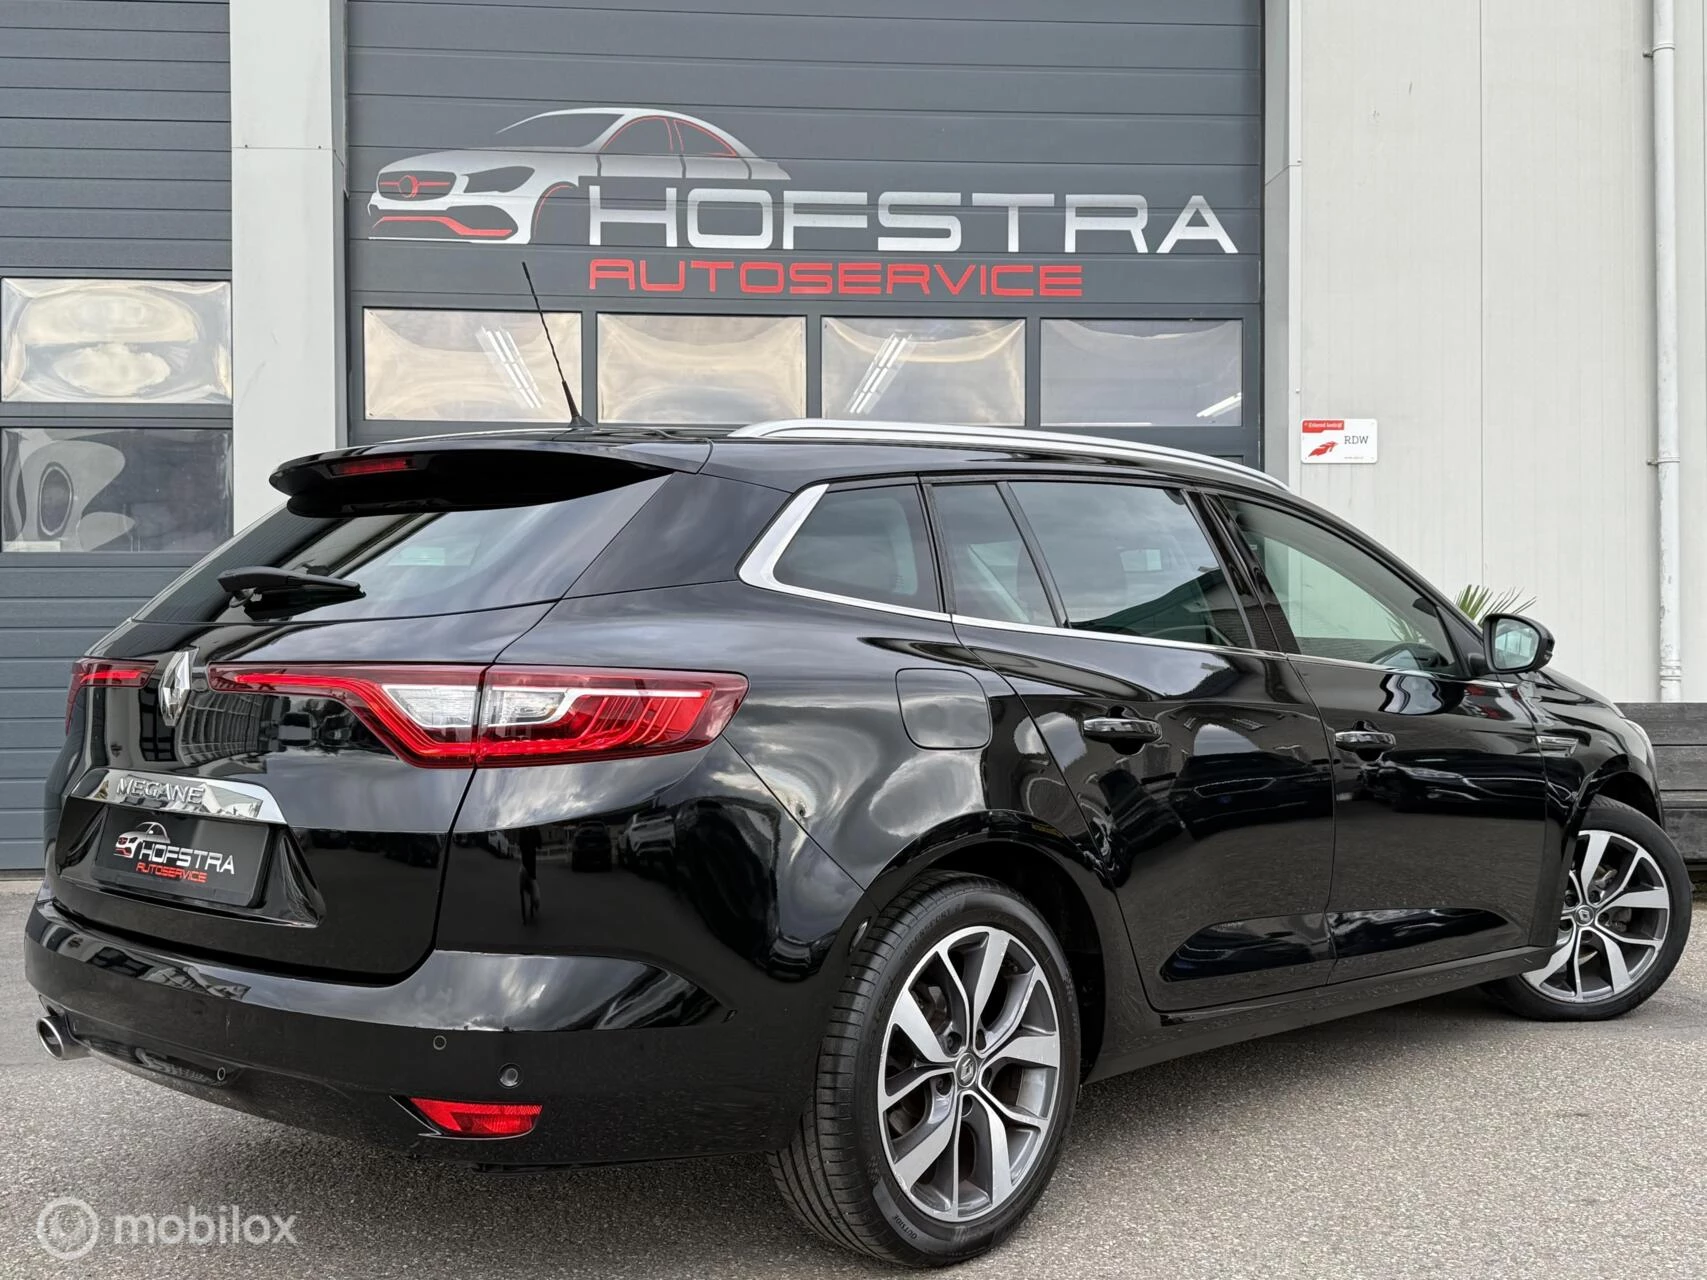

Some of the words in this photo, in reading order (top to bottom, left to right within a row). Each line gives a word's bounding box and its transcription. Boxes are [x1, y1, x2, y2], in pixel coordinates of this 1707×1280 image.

[588, 184, 1239, 254] HOFSTRA
[588, 258, 1083, 297] AUTOSERVICE
[1344, 435, 1369, 444] RDW
[116, 777, 206, 804] MEGANE
[136, 861, 208, 883] AUTOSERVICE
[138, 842, 235, 875] HOFSTRA
